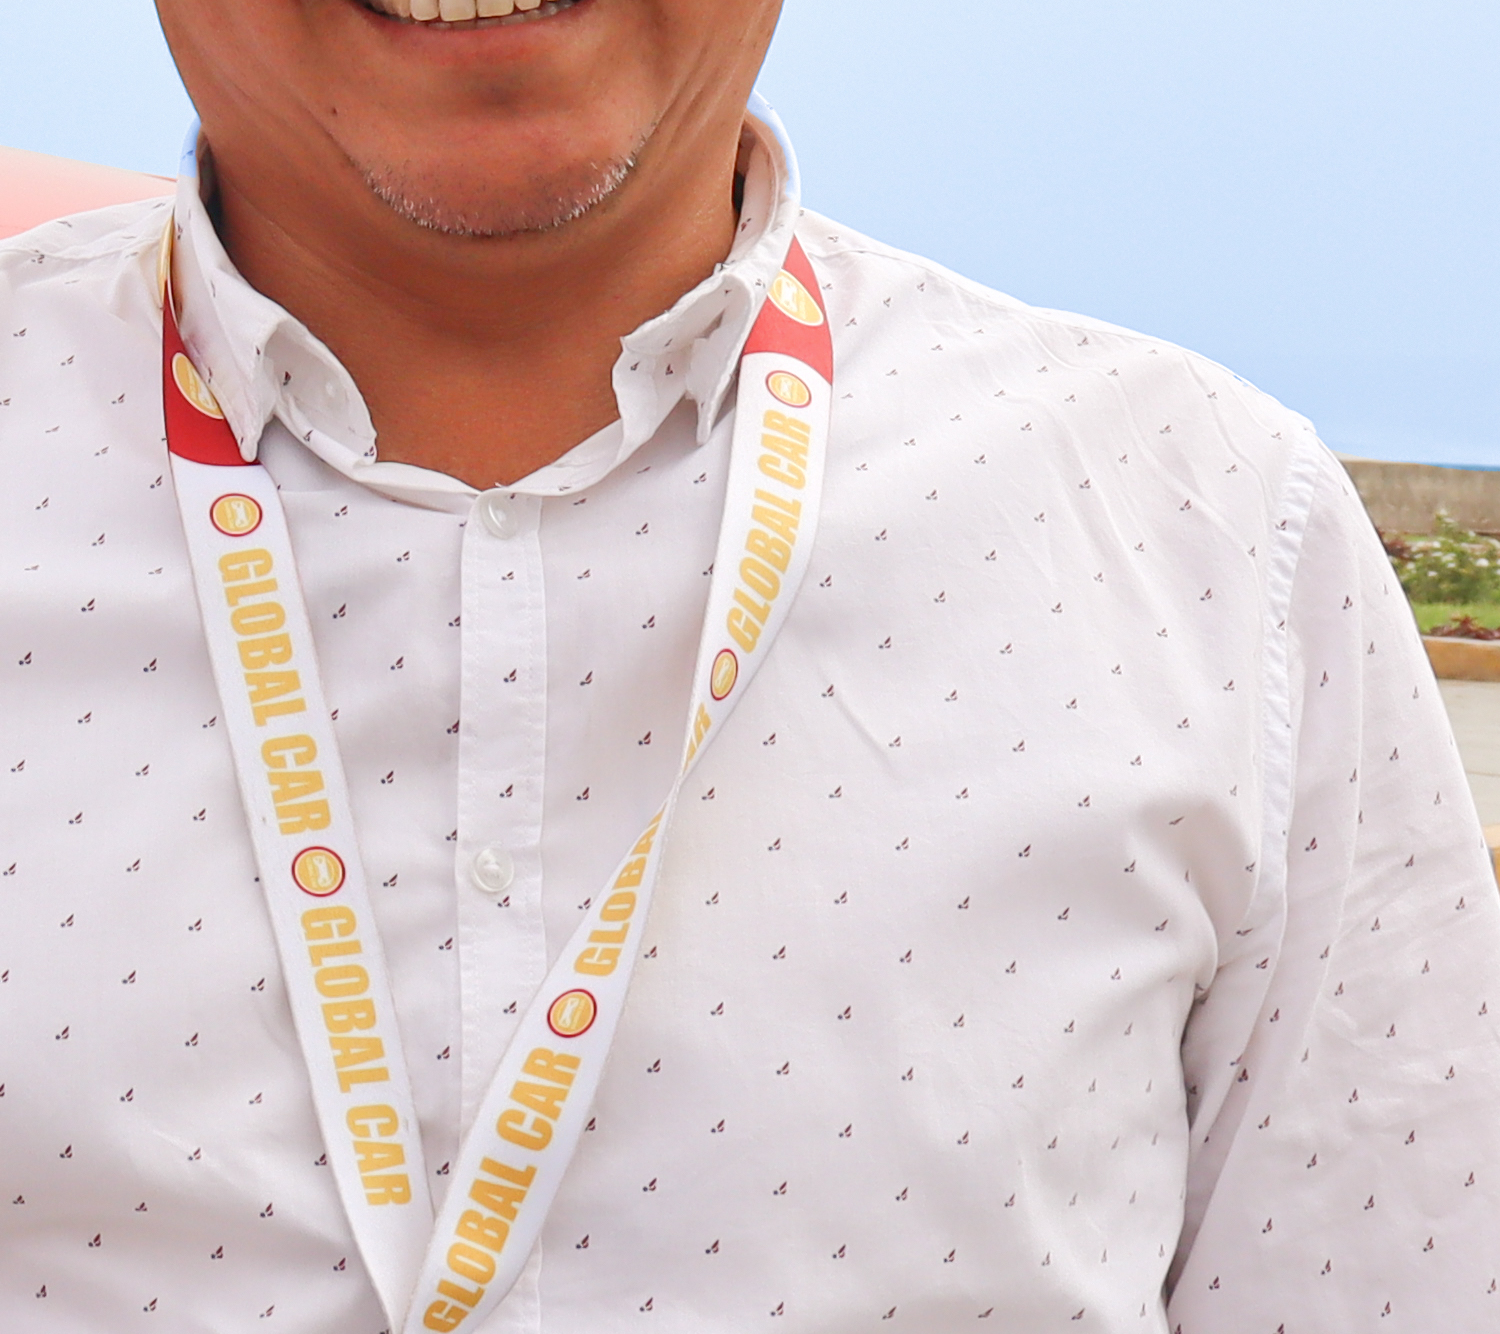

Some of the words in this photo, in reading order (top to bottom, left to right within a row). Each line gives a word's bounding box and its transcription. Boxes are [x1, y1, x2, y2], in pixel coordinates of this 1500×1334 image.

[757, 409, 811, 490] CAR
[218, 548, 307, 727] GLOBAL
[726, 488, 802, 653] GLOBAL
[261, 734, 332, 835] CAR
[301, 905, 391, 1093] GLOBAL
[346, 1104, 412, 1206] CAR
[423, 1156, 538, 1334] GLOBAL
[495, 1047, 581, 1152] CAR
